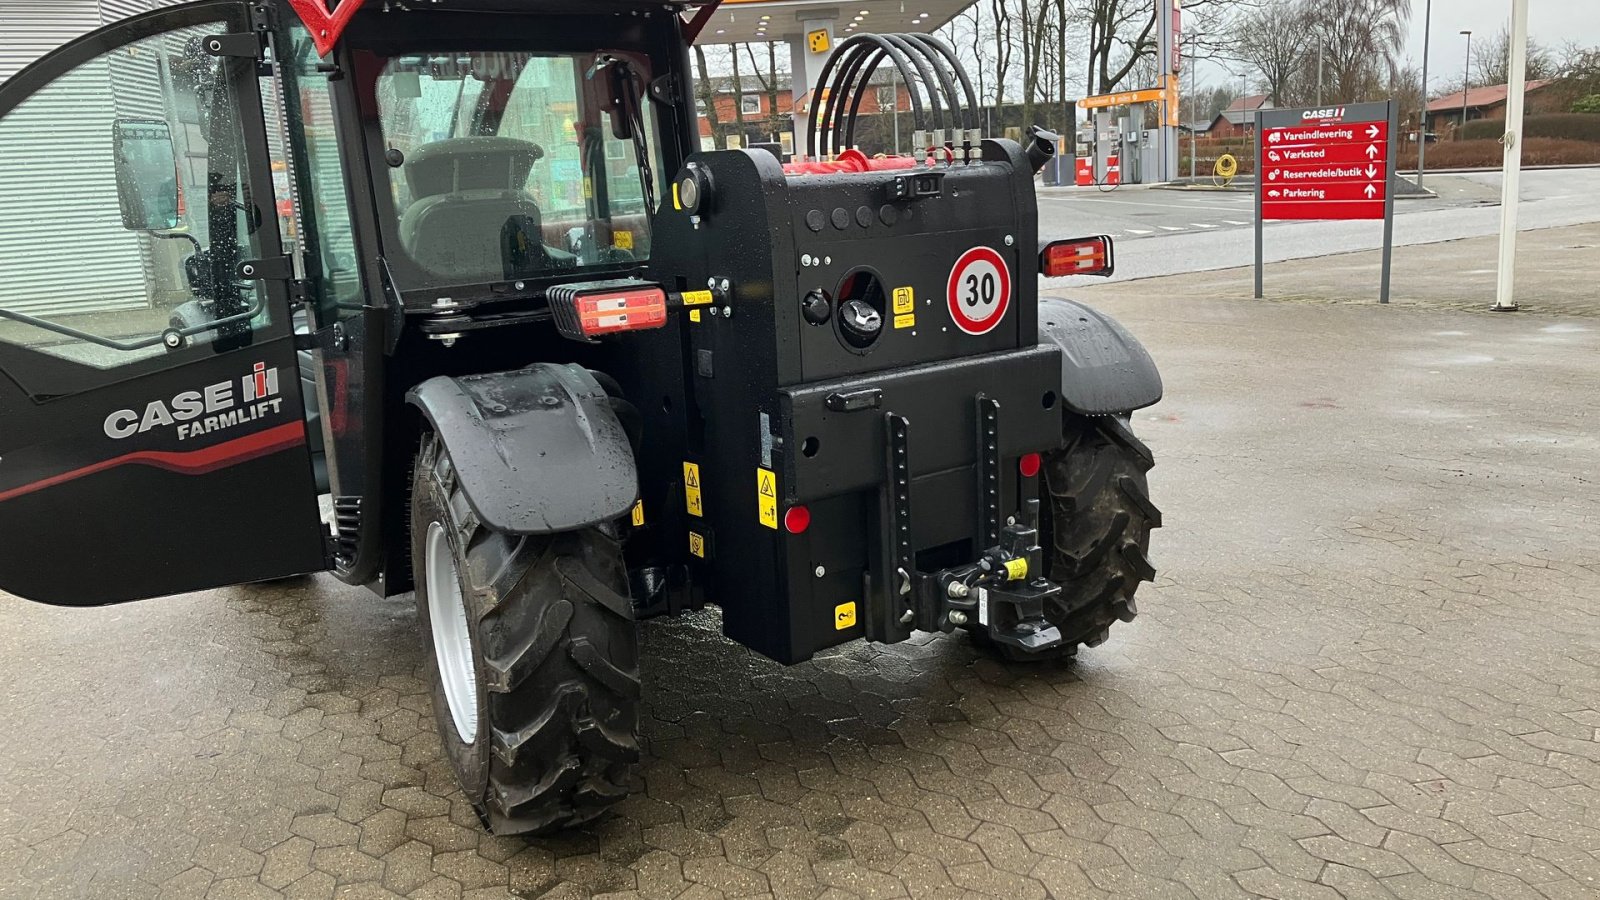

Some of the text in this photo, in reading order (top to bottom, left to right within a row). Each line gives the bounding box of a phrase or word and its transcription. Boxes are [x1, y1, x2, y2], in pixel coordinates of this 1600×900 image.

[1302, 108, 1334, 119] CASE
[1283, 129, 1353, 140] Vareindlevering
[1283, 149, 1325, 159] Værksted
[1283, 167, 1362, 179] Reservedele/butik
[1283, 188, 1325, 198] Parkering
[966, 272, 995, 307] 30
[103, 379, 234, 439] CASE
[177, 397, 283, 441] FARMLIFT
